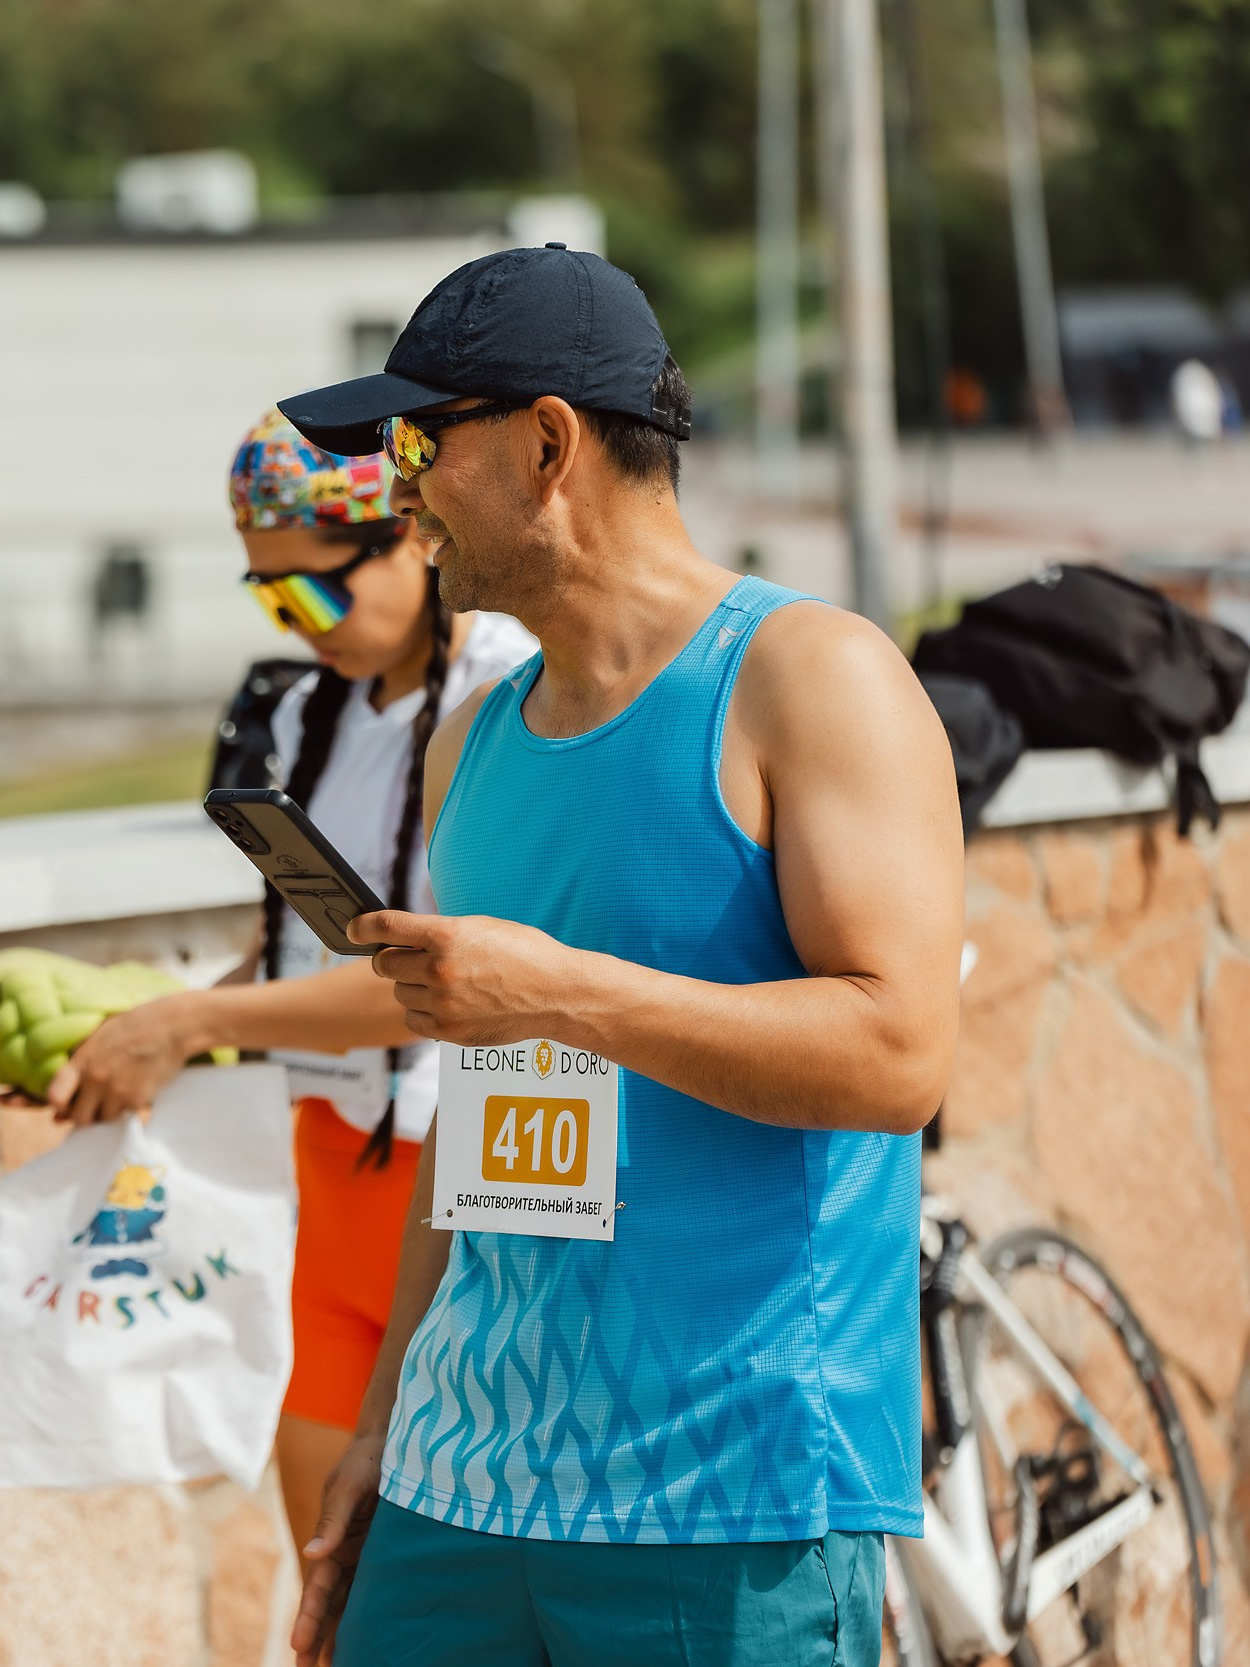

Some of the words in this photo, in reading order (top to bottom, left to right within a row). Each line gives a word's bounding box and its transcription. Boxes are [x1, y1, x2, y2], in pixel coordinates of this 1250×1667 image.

[461, 1048, 525, 1072] LEONE
[492, 1107, 578, 1174] 410
[457, 1193, 573, 1213] БЛАГОТВОРИТЕЛЬНЫЙ
[575, 1201, 602, 1216] ЗАБЕГ
